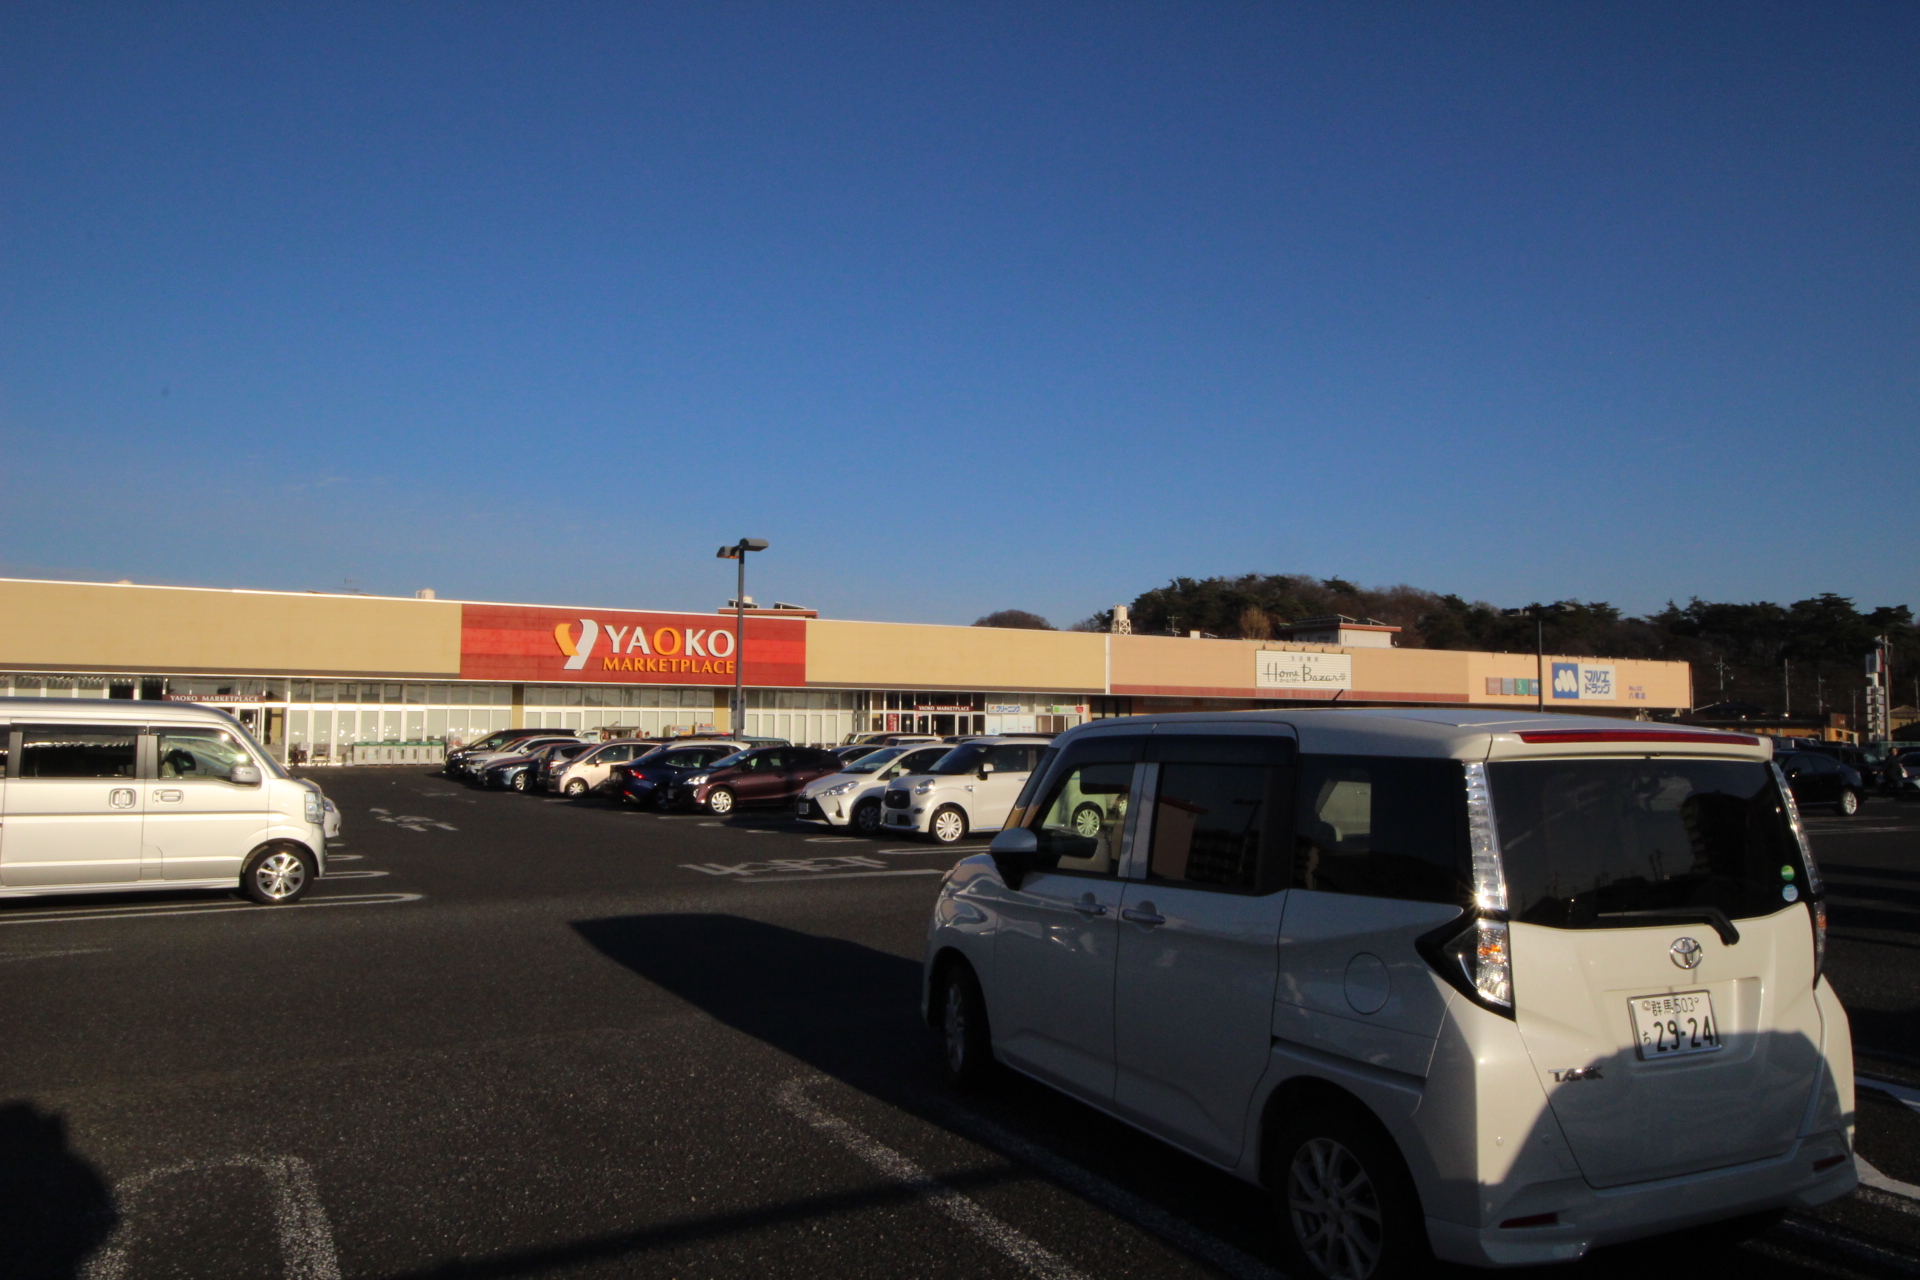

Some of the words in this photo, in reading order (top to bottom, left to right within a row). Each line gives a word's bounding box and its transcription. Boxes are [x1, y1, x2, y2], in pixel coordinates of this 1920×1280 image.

[604, 624, 735, 658] YAOKO
[602, 657, 735, 675] MARKETPLACE
[1262, 662, 1300, 682] Home
[1301, 663, 1340, 682] Bazar
[1584, 670, 1610, 683] マルエ
[1584, 683, 1611, 694] ドラッグ
[996, 704, 1021, 713] クリーニング
[1651, 998, 1675, 1016] 群馬
[1674, 997, 1695, 1014] 503
[1642, 1030, 1652, 1047] ち
[1653, 1015, 1714, 1053] 29-24
